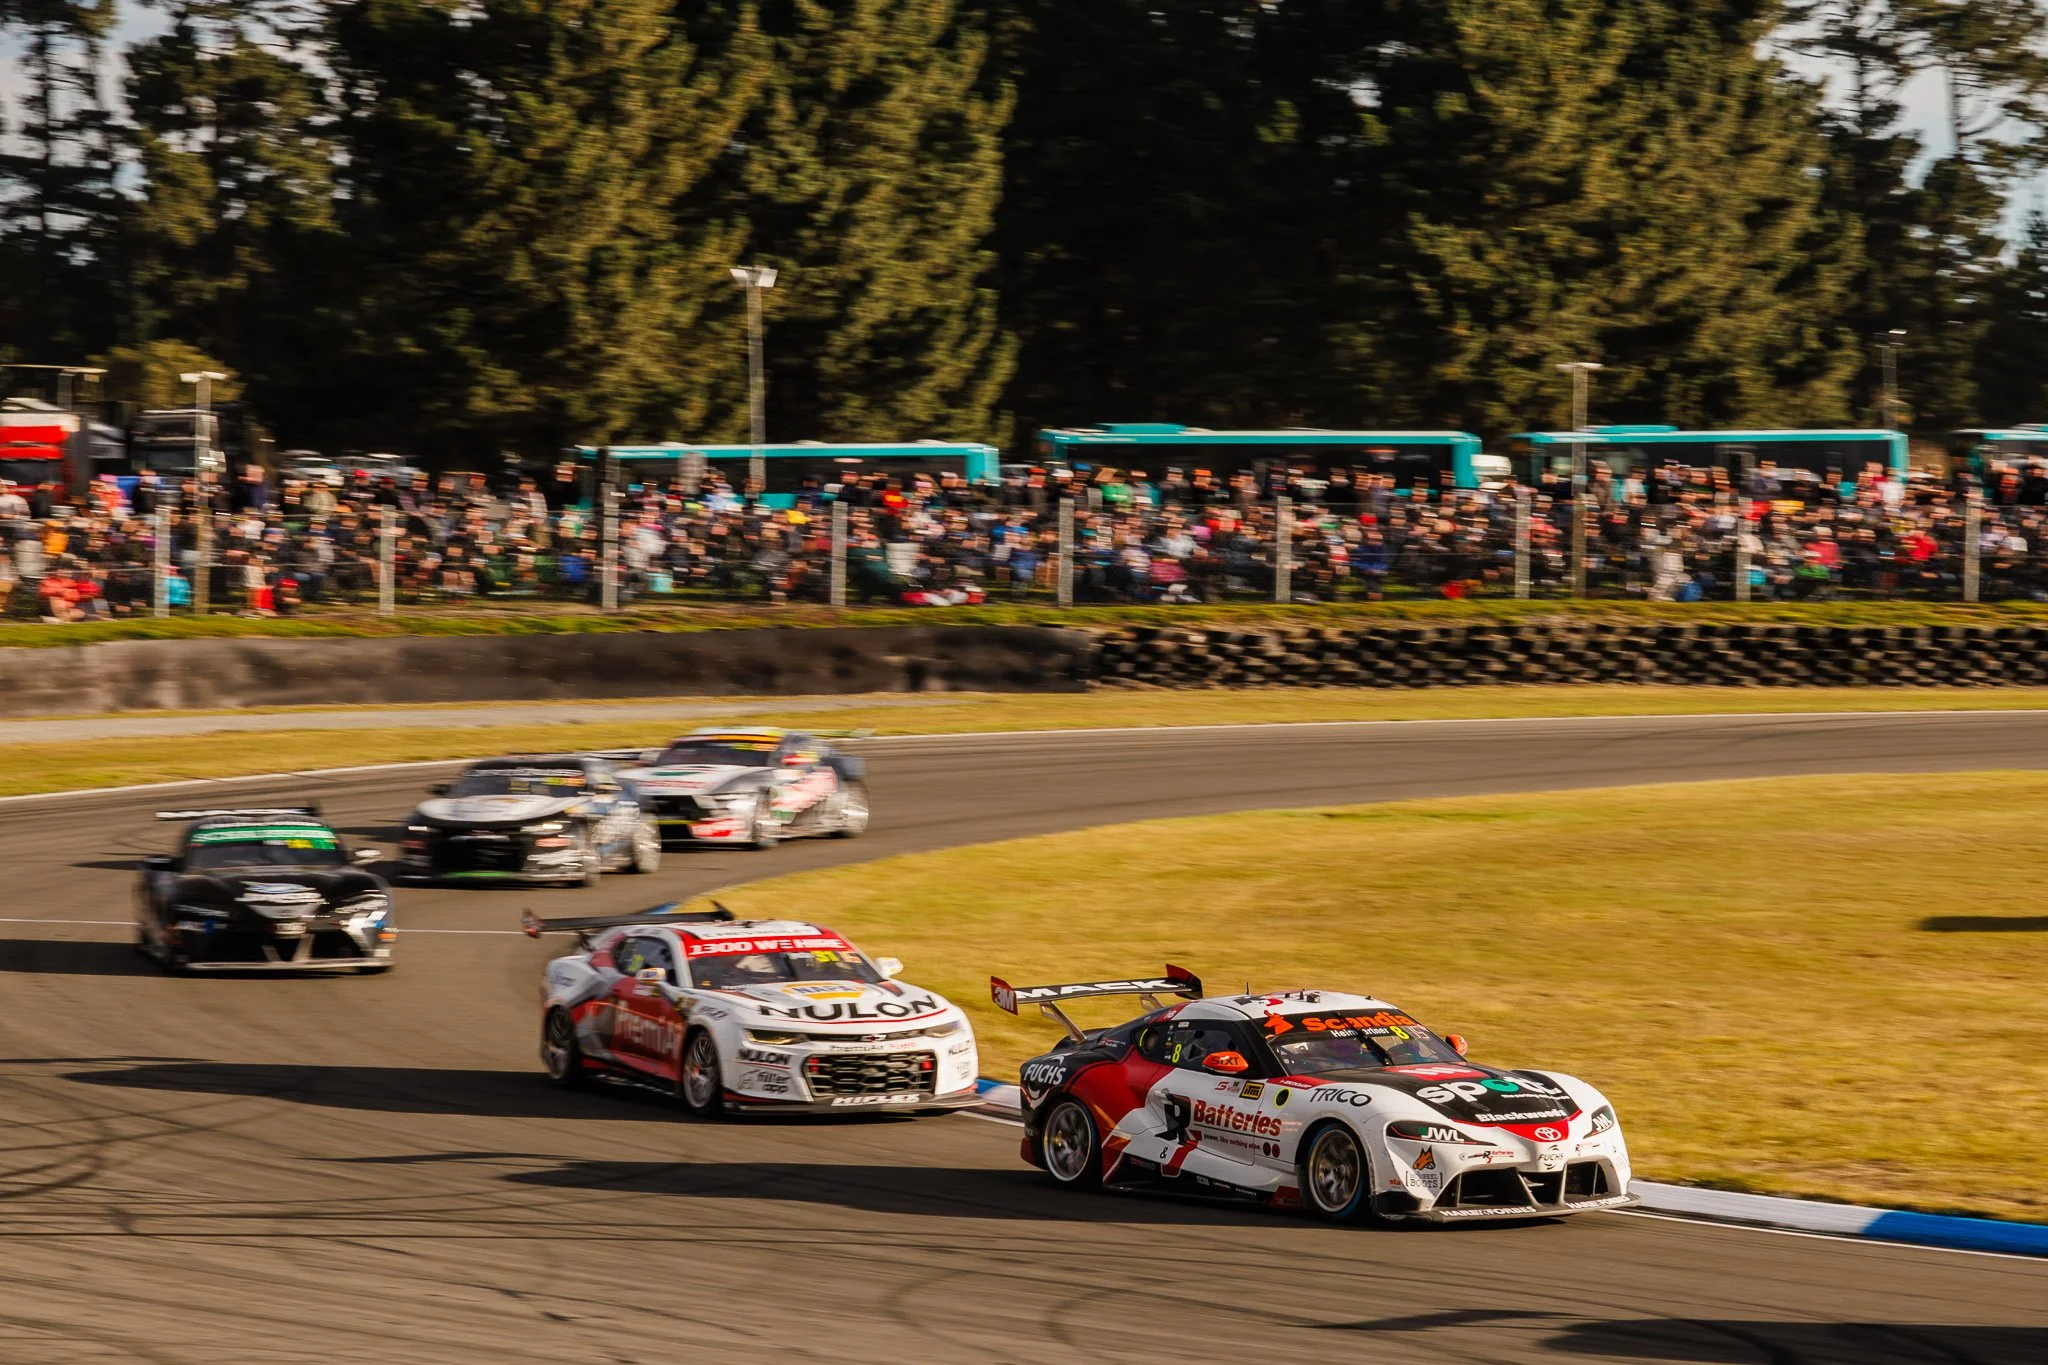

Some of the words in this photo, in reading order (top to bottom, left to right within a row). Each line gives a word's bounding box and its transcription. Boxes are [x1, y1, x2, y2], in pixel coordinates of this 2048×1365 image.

[687, 941, 752, 955] 1300
[753, 939, 792, 950] WE
[793, 938, 847, 950] HIRE
[1016, 979, 1179, 999] MACK
[759, 995, 939, 1020] NULON
[994, 986, 1015, 1011] 3M
[1302, 1011, 1417, 1032] Scandia
[1331, 1027, 1389, 1038] Heimartner
[1390, 1025, 1410, 1040] 8
[738, 1049, 793, 1065] NULON
[1172, 1043, 1182, 1063] 8
[1023, 1063, 1067, 1086] FUCHS
[1310, 1087, 1372, 1107] TRICO
[1193, 1099, 1282, 1137] Batteries
[1475, 1108, 1567, 1122] Blackwoods
[1592, 1113, 1613, 1131] JWL
[1421, 1126, 1464, 1142] JWL
[1159, 1146, 1168, 1159] &
[1538, 1153, 1564, 1161] FUCHS
[1410, 1178, 1438, 1188] BOOTS
